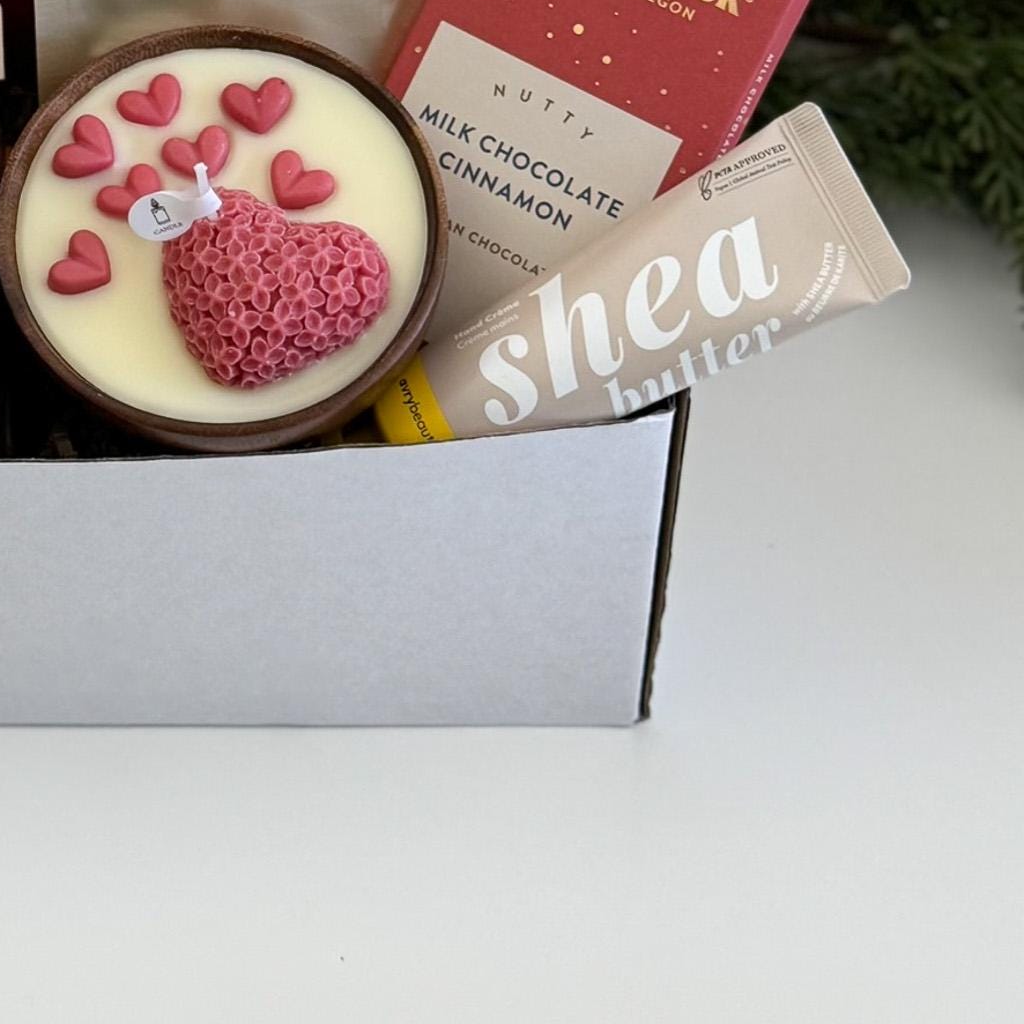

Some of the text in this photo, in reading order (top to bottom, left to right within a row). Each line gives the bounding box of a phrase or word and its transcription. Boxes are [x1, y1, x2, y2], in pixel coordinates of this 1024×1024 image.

[493, 83, 595, 141] NUTTY
[419, 104, 625, 219] MILK CHOCOLATE
[438, 151, 573, 231] CINNAMON
[734, 143, 787, 171] APPROVED
[468, 231, 546, 276] CHOCOLA
[478, 216, 779, 426] shea
[602, 317, 782, 418] butter
